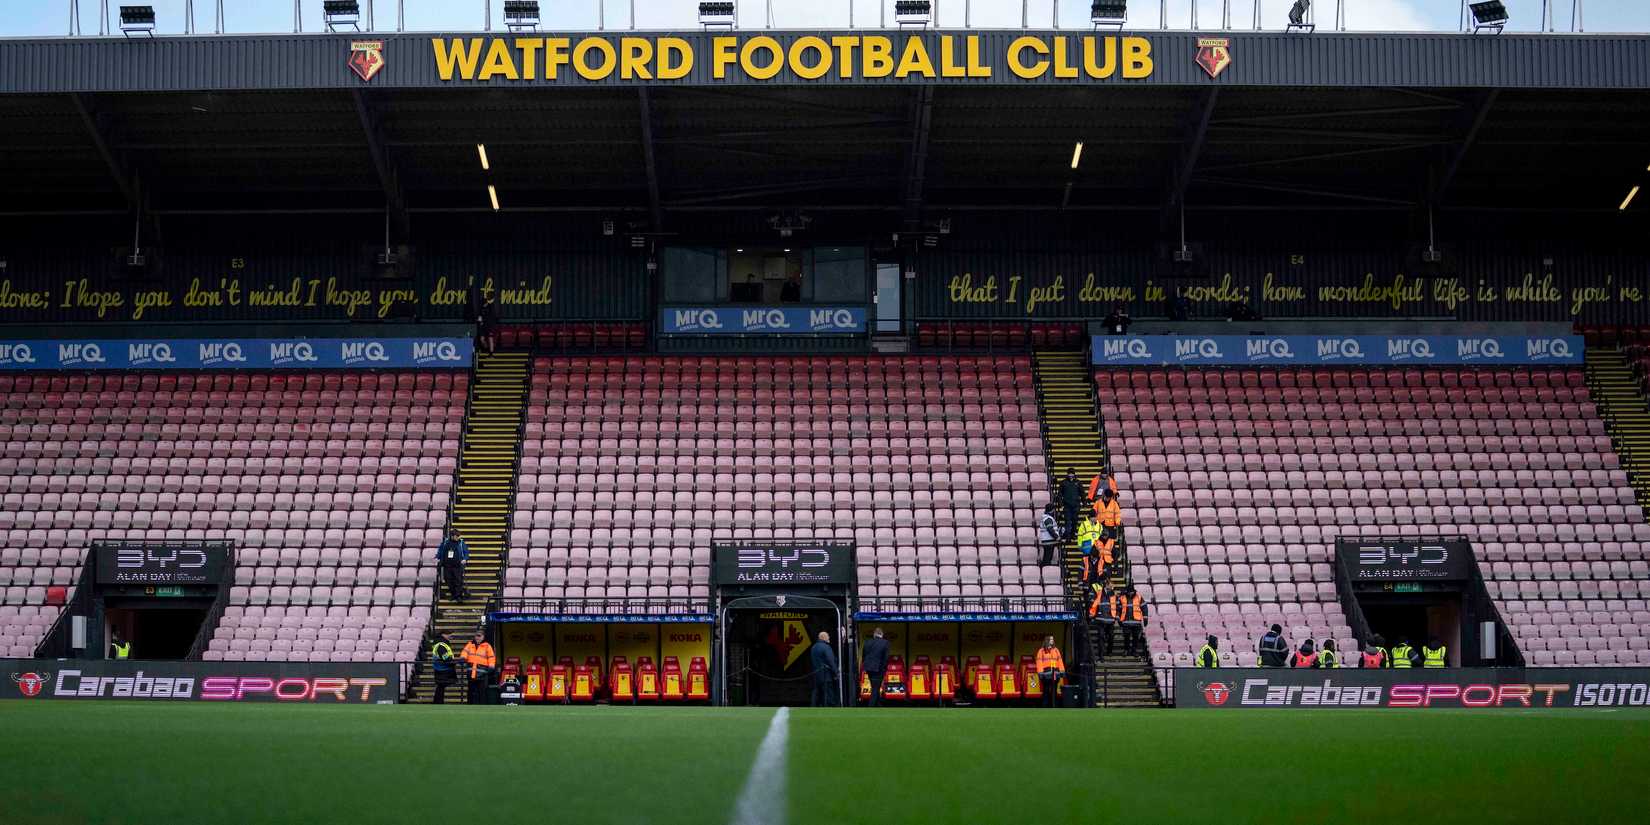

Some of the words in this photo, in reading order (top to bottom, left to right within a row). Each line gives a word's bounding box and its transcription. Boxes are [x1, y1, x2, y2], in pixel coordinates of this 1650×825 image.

[432, 37, 694, 81] WATFORD
[713, 36, 992, 80] FOOTBALL
[1007, 36, 1154, 79] CLUB
[231, 258, 245, 269] E3
[1291, 255, 1305, 265] E4
[60, 280, 76, 308] I
[77, 278, 125, 318] hope
[132, 289, 174, 320] you
[183, 277, 241, 307] don't
[249, 277, 302, 307] mind
[304, 279, 321, 307] I
[325, 277, 372, 317] hope
[500, 275, 552, 305] mind
[948, 273, 999, 303] that
[1006, 276, 1022, 303] I
[1027, 275, 1065, 313] put
[1078, 273, 1137, 302] down
[1144, 280, 1167, 302] in
[1262, 273, 1306, 301] how
[1318, 272, 1424, 310] wonderful
[1432, 277, 1471, 311] life
[1475, 279, 1498, 303] is
[1504, 273, 1563, 303] while
[675, 309, 723, 328] MrQ
[743, 309, 791, 328] MrQ
[810, 309, 858, 328] MrQ
[59, 343, 106, 362] MrQ
[129, 343, 176, 362] MrQ
[200, 342, 247, 362] MrQ
[270, 342, 318, 361] MrQ
[341, 342, 389, 361] MrQ
[413, 341, 461, 361] MrQ
[1104, 339, 1152, 358] MrQ
[1175, 339, 1223, 358] MrQ
[1246, 339, 1294, 358] MrQ
[1317, 339, 1364, 358] MrQ
[1388, 339, 1435, 358] MrQ
[1457, 339, 1504, 357] MrQ
[1527, 339, 1573, 357] MrQ
[117, 549, 207, 568] BYD
[738, 549, 830, 568] BYD
[1360, 546, 1448, 564] BYD
[116, 573, 148, 581] ALAN
[150, 573, 171, 581] DAY
[737, 573, 769, 581] ALAN
[772, 573, 794, 581] DAY
[1359, 569, 1390, 577] ALAN
[1393, 569, 1414, 577] DAY
[669, 633, 703, 642] KOKA
[54, 669, 195, 698] Carabao
[201, 677, 388, 700] SPORT
[1241, 679, 1383, 705] Carabao
[1387, 683, 1571, 706] SPORT
[1573, 683, 1650, 706] ISOTO
